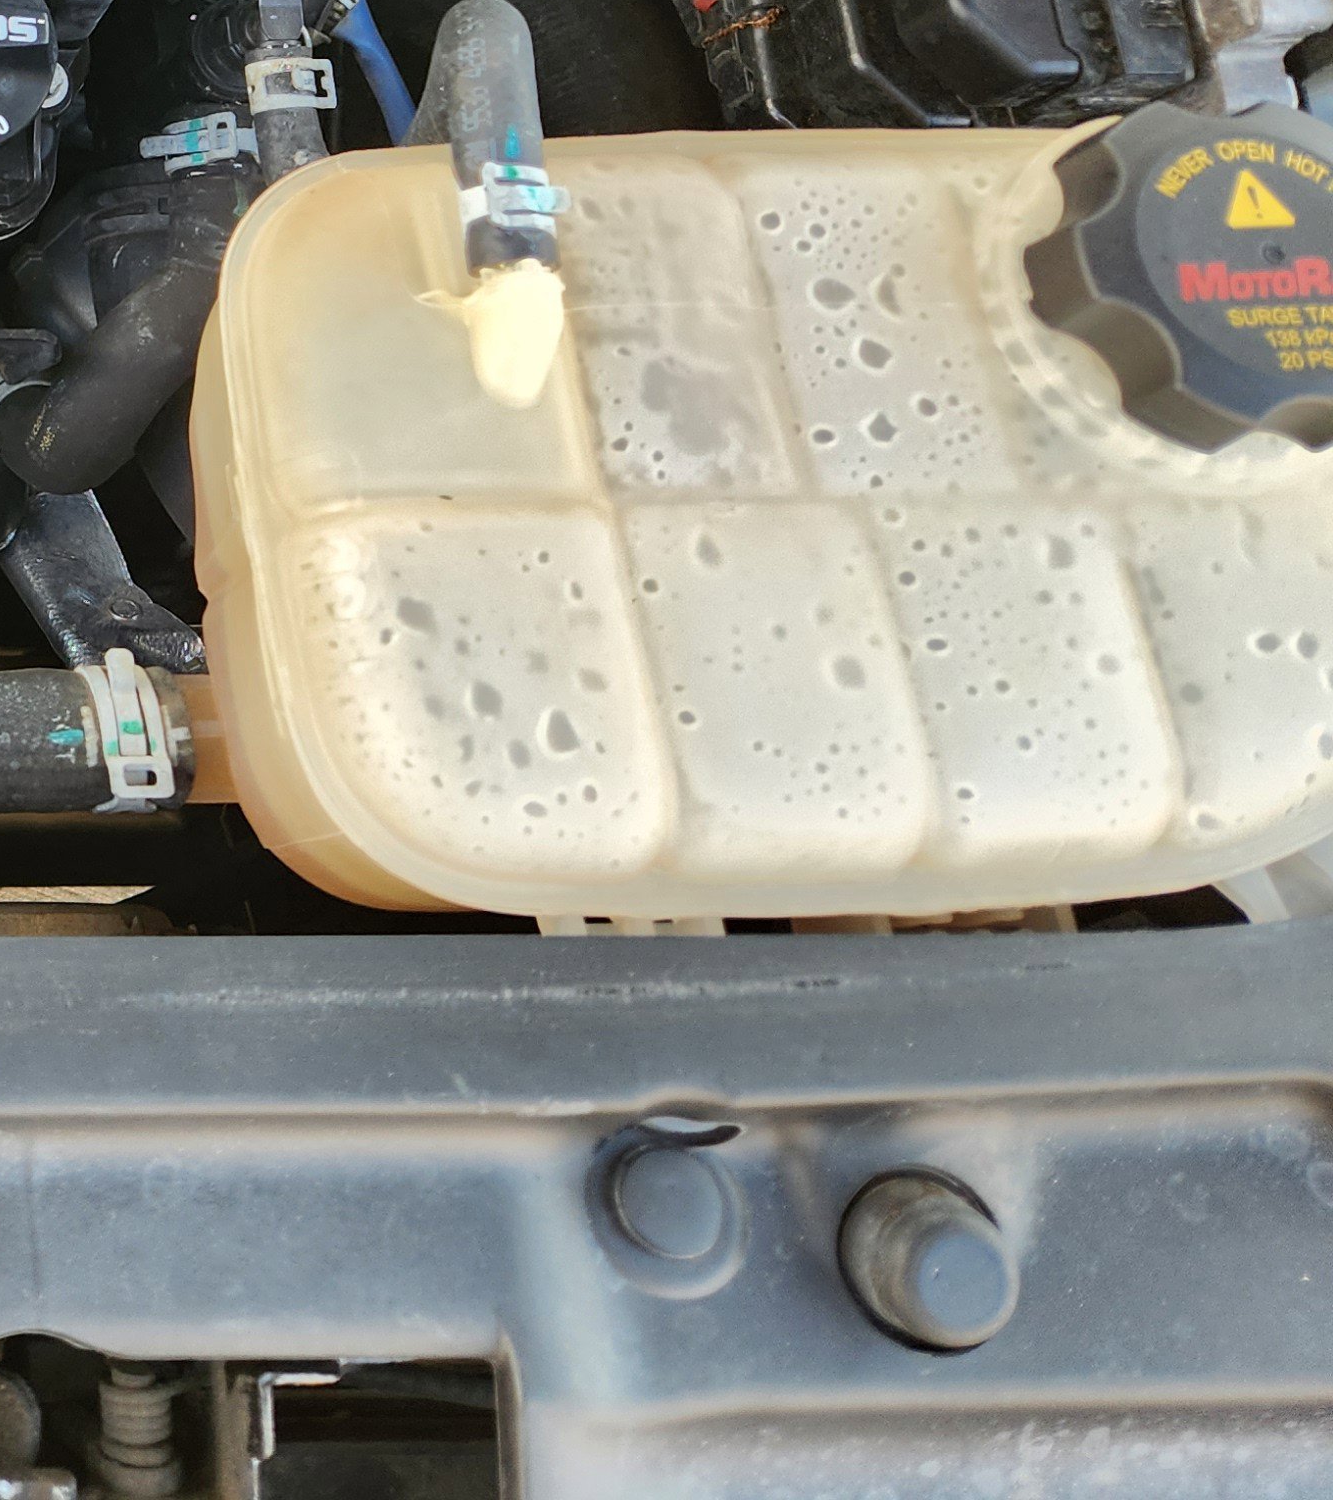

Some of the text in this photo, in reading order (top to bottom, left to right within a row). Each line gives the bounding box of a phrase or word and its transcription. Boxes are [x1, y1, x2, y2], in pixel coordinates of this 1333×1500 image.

[1154, 138, 1330, 199] NEVER OPEN HOT
[1226, 305, 1303, 329] SURGE
[1278, 351, 1305, 372] 20
